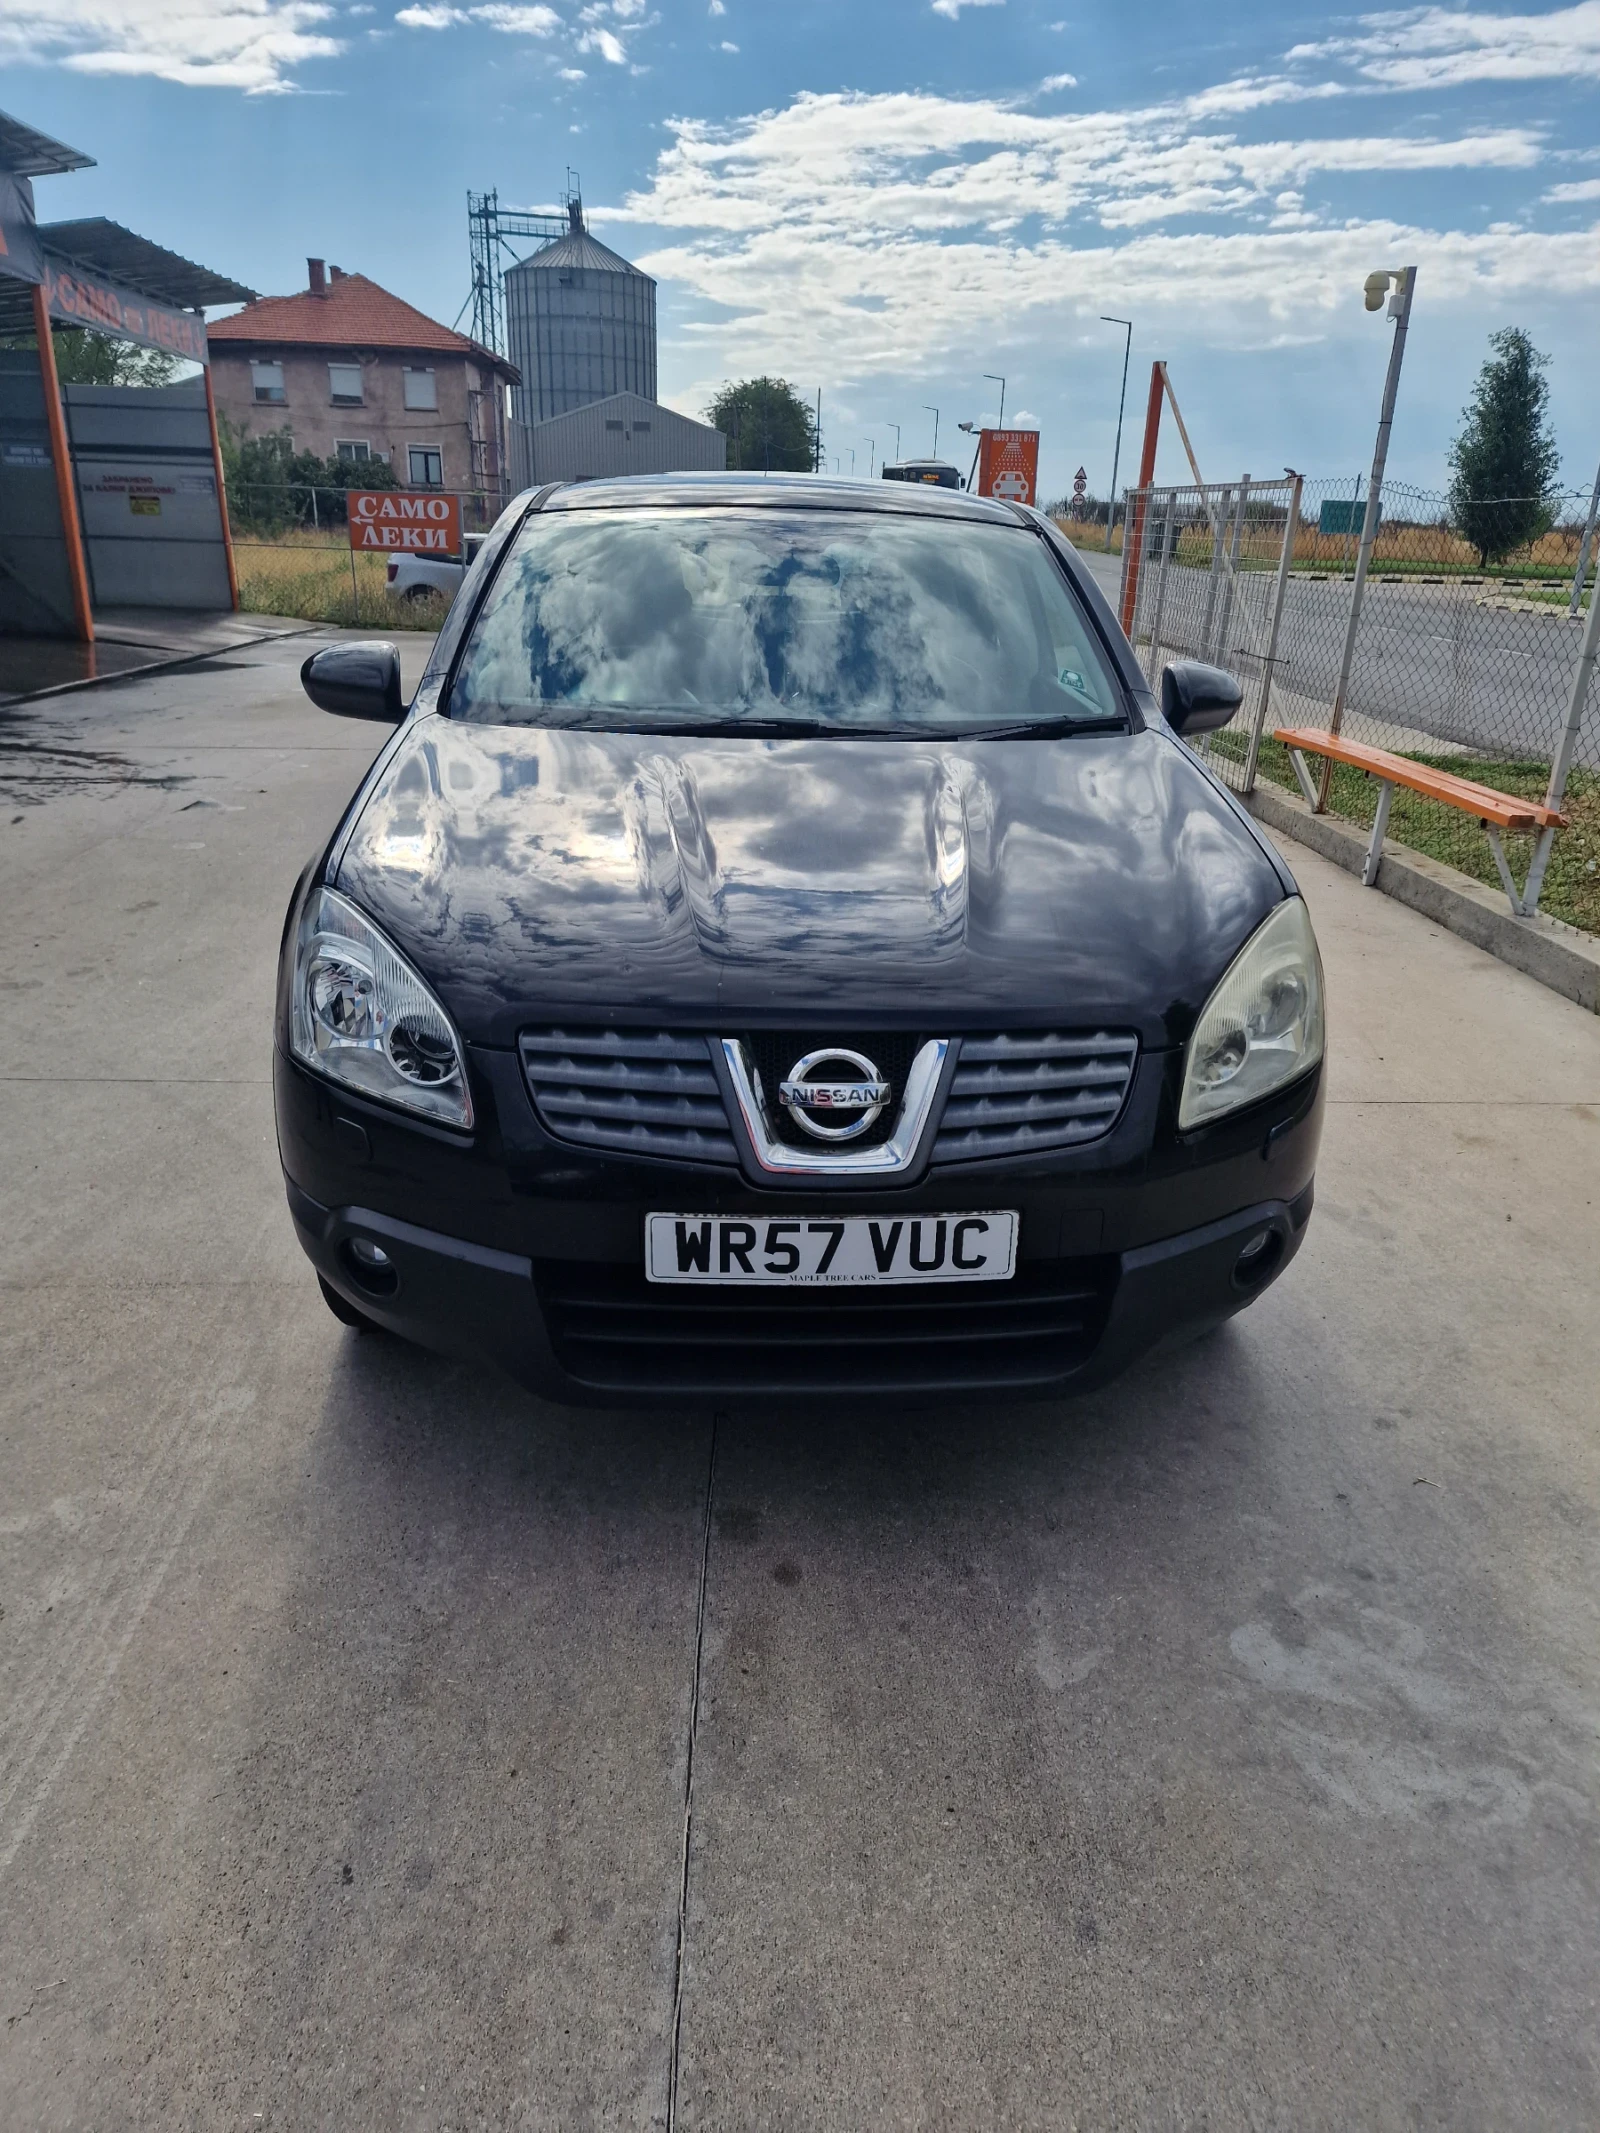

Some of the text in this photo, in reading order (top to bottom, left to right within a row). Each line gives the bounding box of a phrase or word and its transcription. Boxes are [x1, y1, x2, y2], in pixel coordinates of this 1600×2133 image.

[57, 273, 121, 329] САМО
[357, 496, 450, 520] САМО
[361, 525, 449, 549] ЛЕКИ
[792, 1088, 879, 1103] NISSAN
[674, 1218, 989, 1274] WR57 VUC
[789, 1274, 822, 1282] MAPLE
[825, 1274, 849, 1282] TREE
